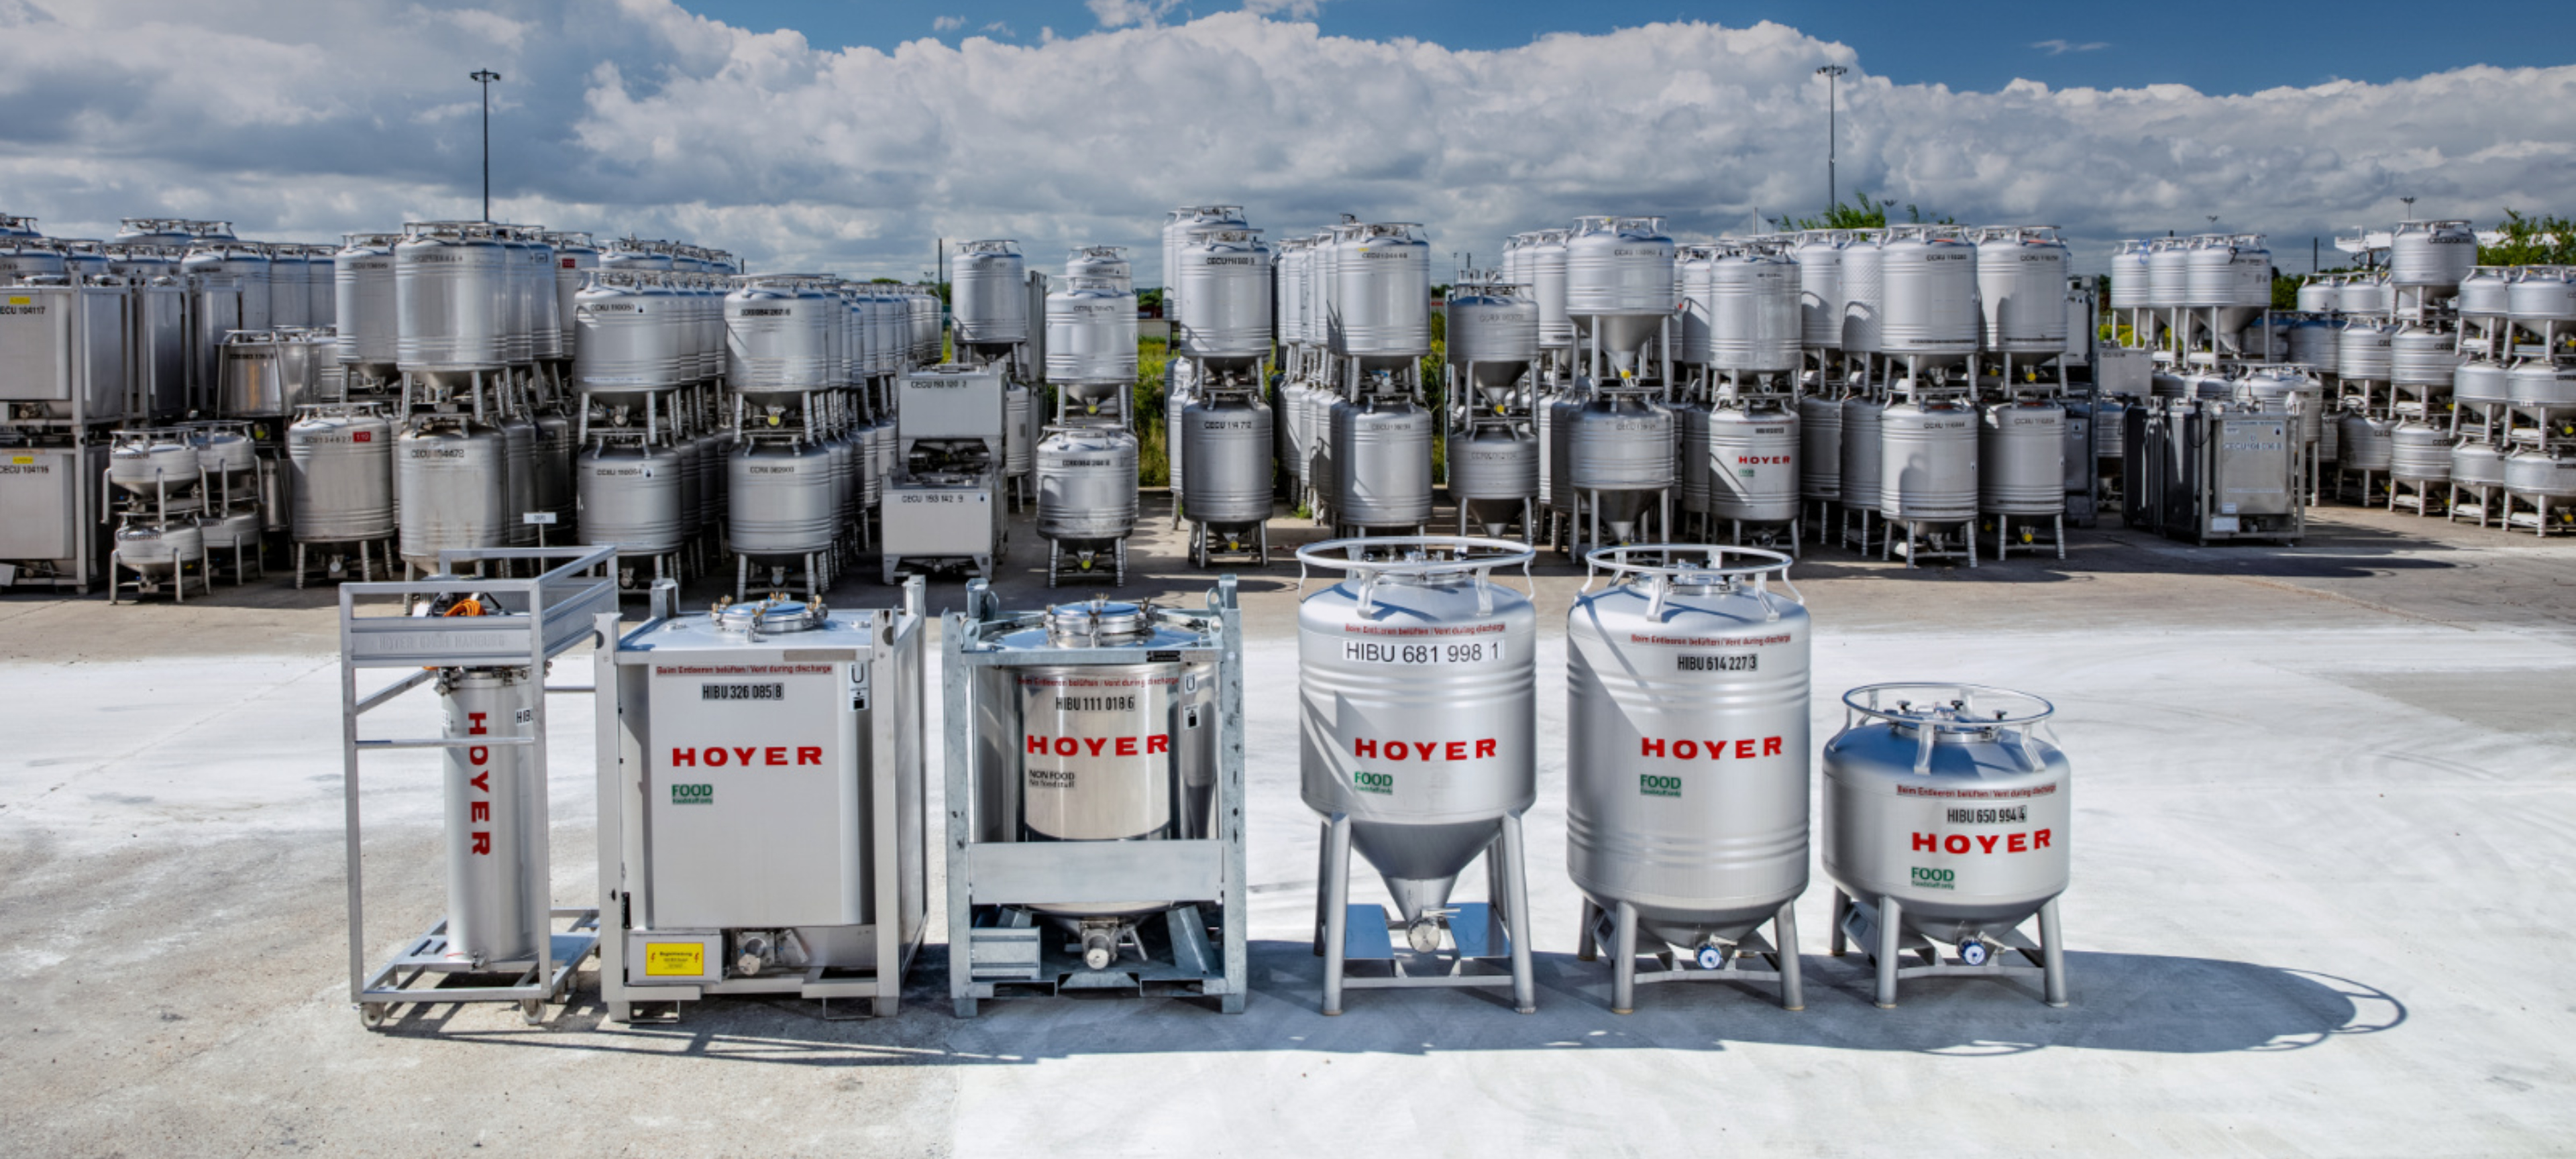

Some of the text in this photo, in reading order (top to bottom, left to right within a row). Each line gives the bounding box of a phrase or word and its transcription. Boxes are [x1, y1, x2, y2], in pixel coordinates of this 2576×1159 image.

[1739, 455, 1790, 464] HOYER
[902, 495, 922, 503] CECU
[1346, 643, 1498, 663] HIBU 681 998 1
[1678, 655, 1756, 670] HIBU 614 227 3
[703, 684, 728, 699] HIBU
[731, 684, 749, 699] 326
[752, 684, 771, 698] 085
[1056, 695, 1134, 711] HIBU 111 018 6
[517, 710, 533, 724] HIB
[1026, 734, 1169, 757] HOYER
[1354, 738, 1497, 761] HOYER
[1642, 736, 1782, 760] HOYER
[672, 747, 823, 767] HOYER
[1030, 769, 1075, 780] NON FOOD
[1354, 771, 1393, 787] FOOD
[1640, 774, 1682, 789] FOOD
[468, 712, 491, 856] HOYER
[672, 784, 712, 797] FOOD
[1947, 809, 1974, 823] HIBU
[1977, 809, 1996, 823] 650
[1998, 808, 2017, 822] 994
[1911, 828, 2051, 854] HOYER
[1911, 867, 1955, 881] FOOD
